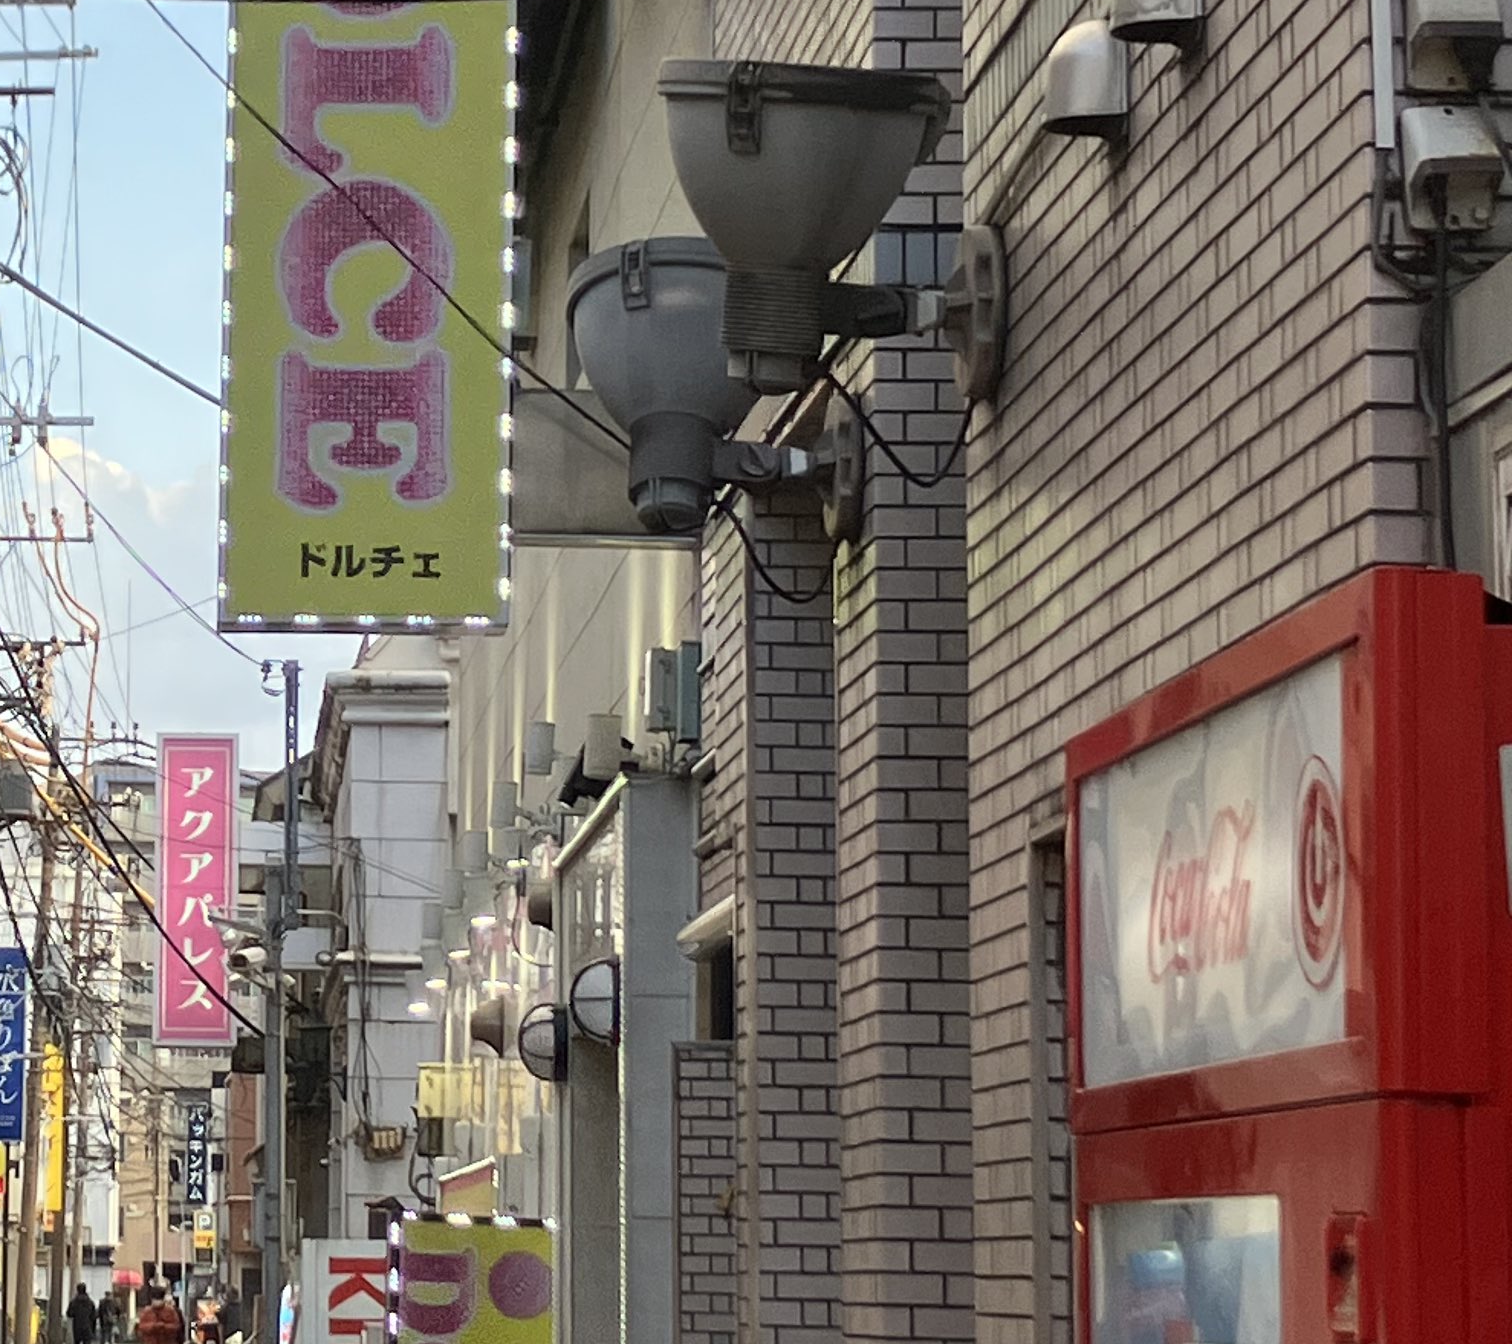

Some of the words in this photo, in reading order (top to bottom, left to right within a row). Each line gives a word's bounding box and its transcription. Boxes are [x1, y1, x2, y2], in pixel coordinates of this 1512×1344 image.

[298, 542, 443, 581] ドルチェ
[177, 766, 216, 1012] アクアパレス
